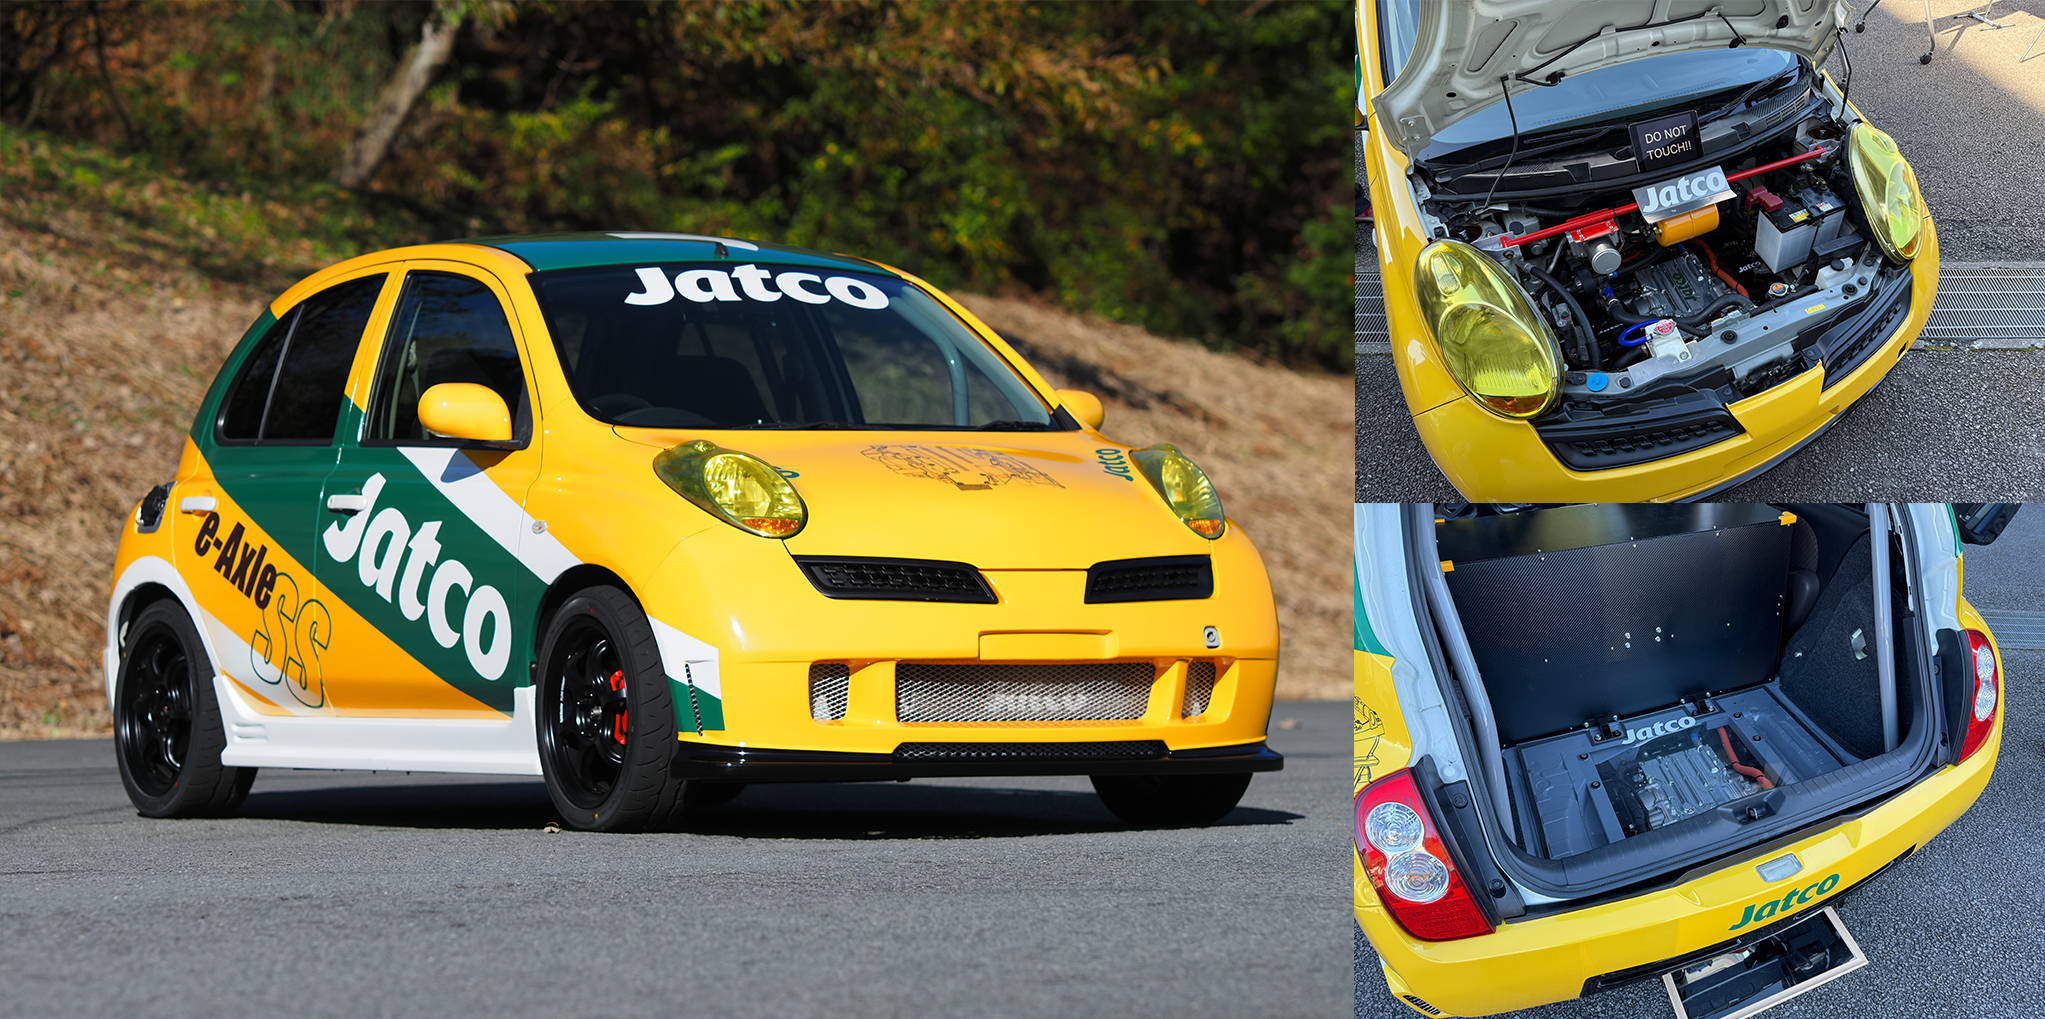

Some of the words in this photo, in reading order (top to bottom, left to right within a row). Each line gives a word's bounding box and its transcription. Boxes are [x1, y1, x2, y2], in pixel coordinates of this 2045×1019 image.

[1644, 131, 1662, 144] DO
[1664, 125, 1687, 139] NOT
[1646, 140, 1692, 160] TOUCH!!
[1642, 172, 1727, 213] Jatco
[1738, 261, 1761, 273] Jatco
[624, 263, 890, 310] Jatco
[1095, 448, 1134, 482] Jatco
[322, 472, 512, 681] Jatco
[194, 511, 277, 610] e-Axle
[250, 572, 332, 709] SS
[1621, 716, 1696, 745] Jatco
[1728, 873, 1840, 931] Jatco
